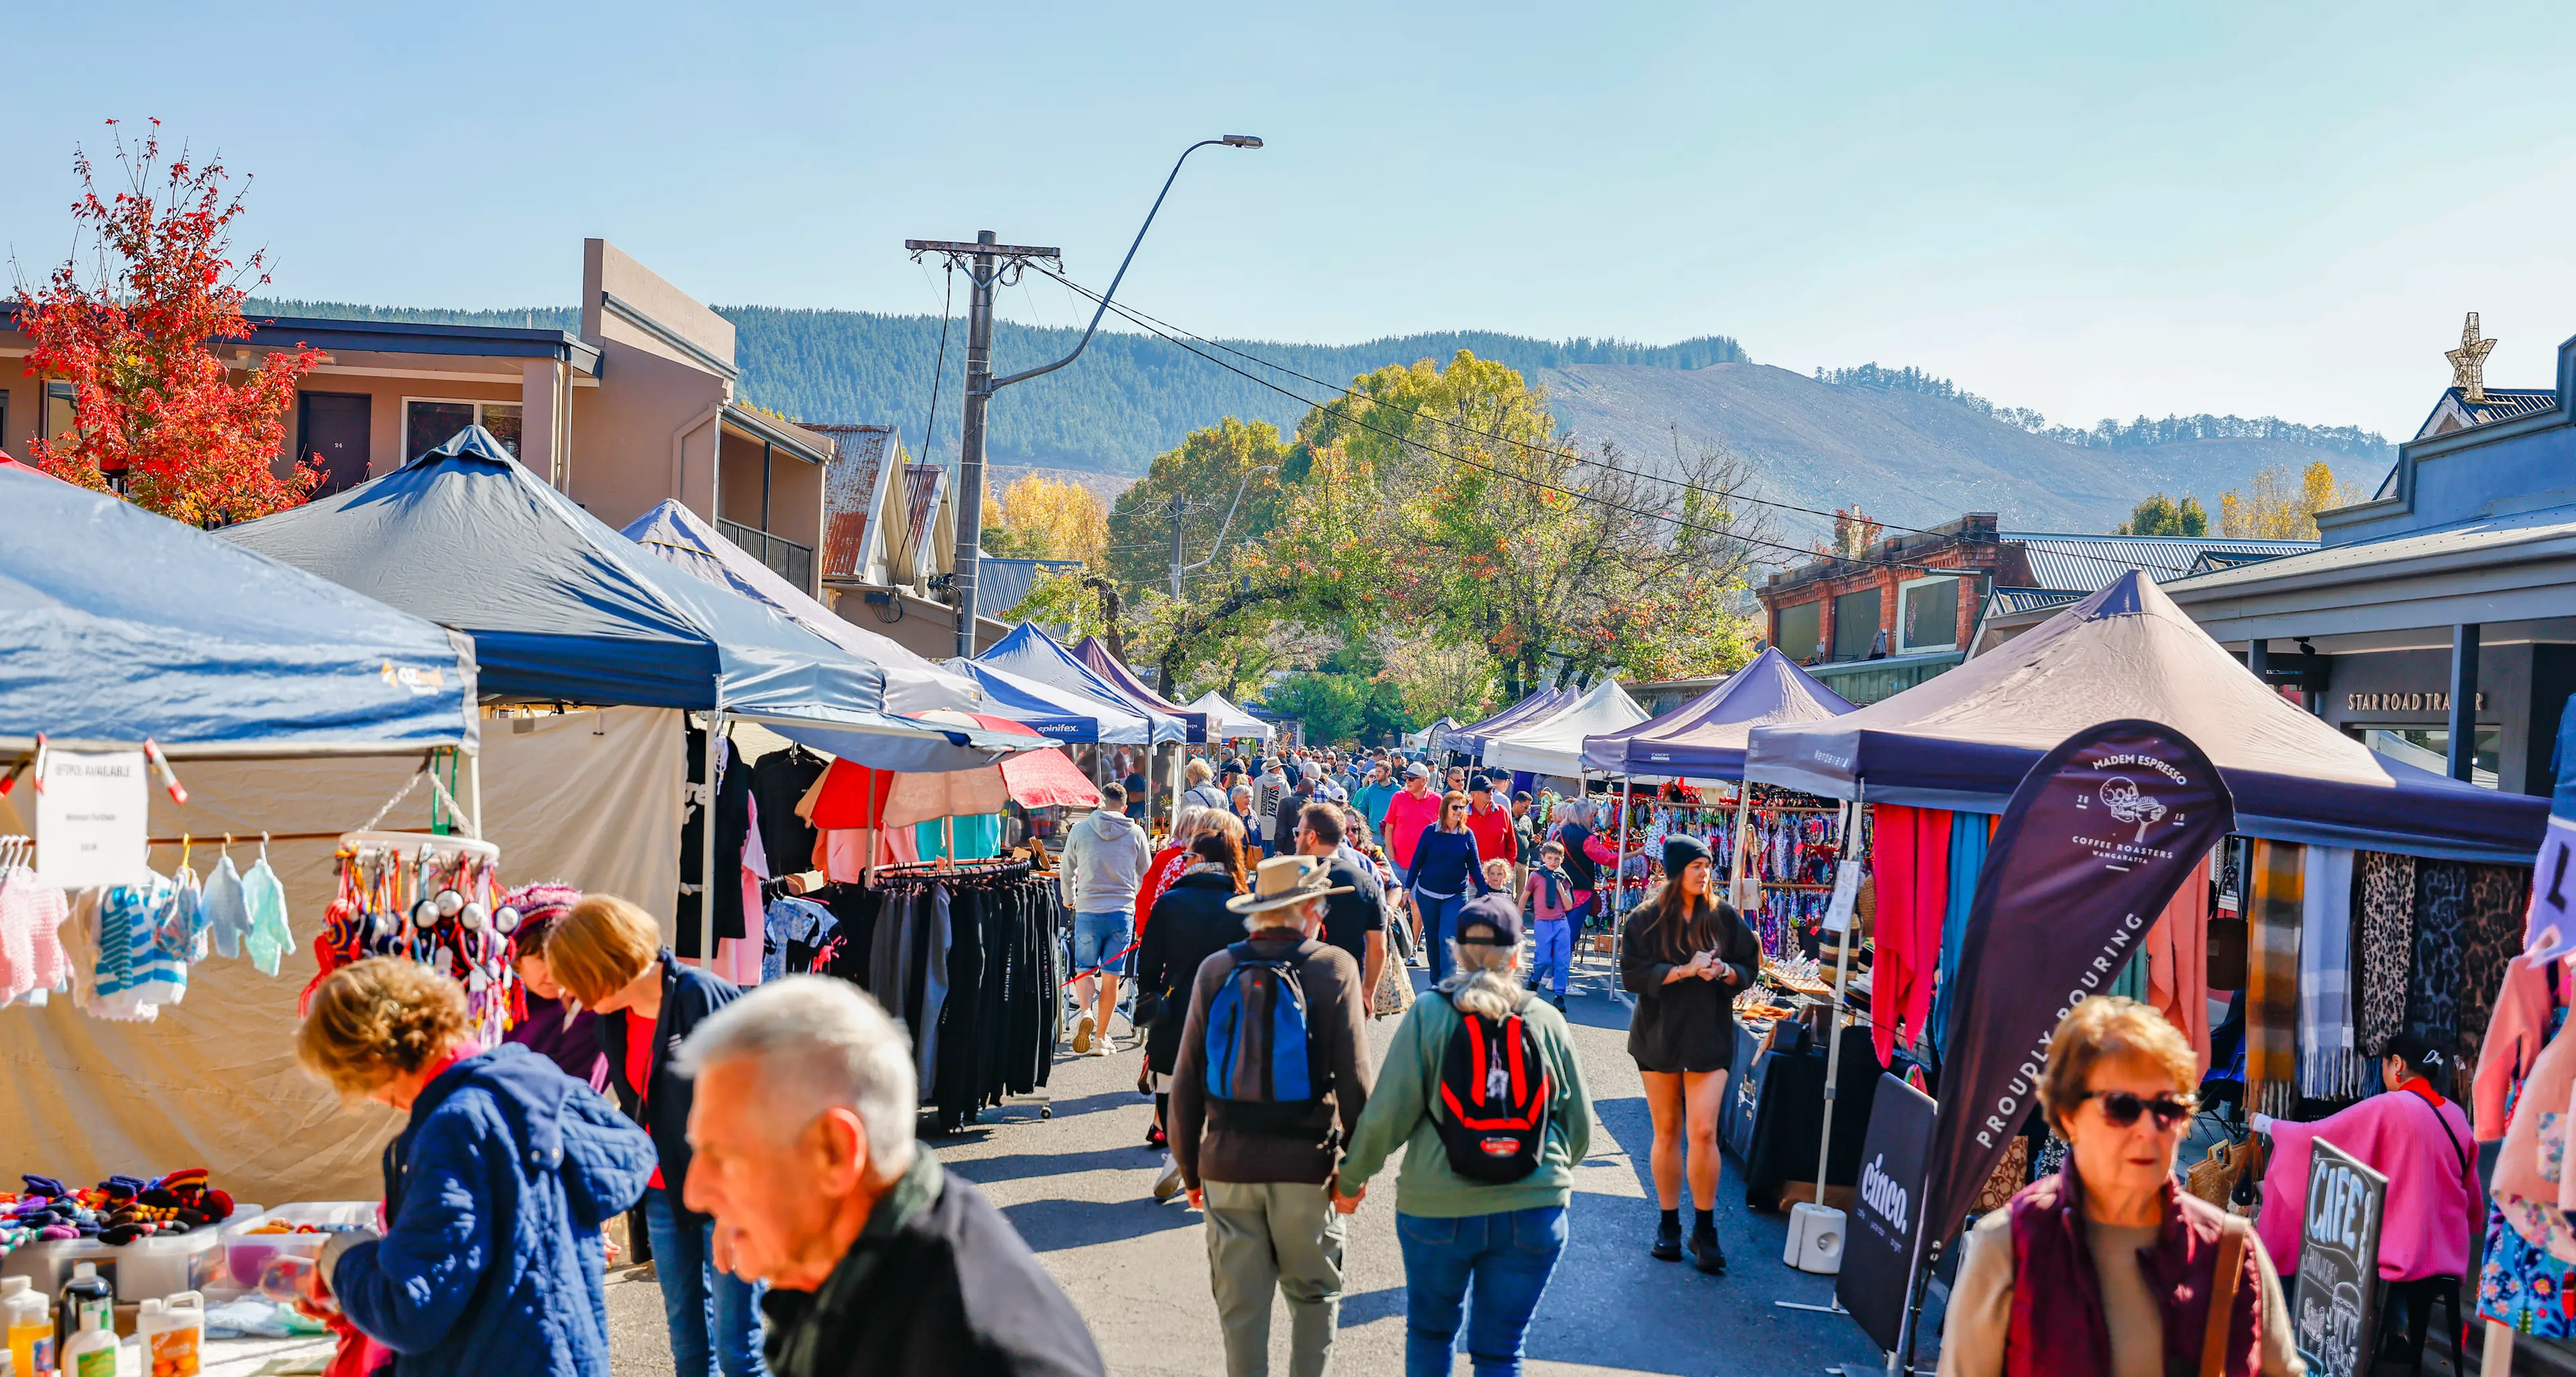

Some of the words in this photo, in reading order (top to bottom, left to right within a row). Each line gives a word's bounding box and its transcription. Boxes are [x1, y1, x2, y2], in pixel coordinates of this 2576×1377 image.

[2348, 694, 2379, 710] STAR
[2382, 693, 2422, 710] ROAD
[2425, 692, 2483, 710] TRAR
[1036, 724, 1079, 733] spinifex.
[2092, 755, 2135, 770] MADEM
[2137, 755, 2187, 785] ESPRESSO
[1267, 788, 1280, 819] SILENT
[2072, 836, 2112, 849] COFFEE
[2116, 844, 2174, 859] ROASTERS
[2092, 850, 2148, 865] WANGARATTA
[1976, 1030, 2054, 1149] PROUDLY
[2056, 913, 2143, 1021] POURING
[1861, 1153, 1908, 1235] cinco.
[2309, 1160, 2364, 1251] CAFE
